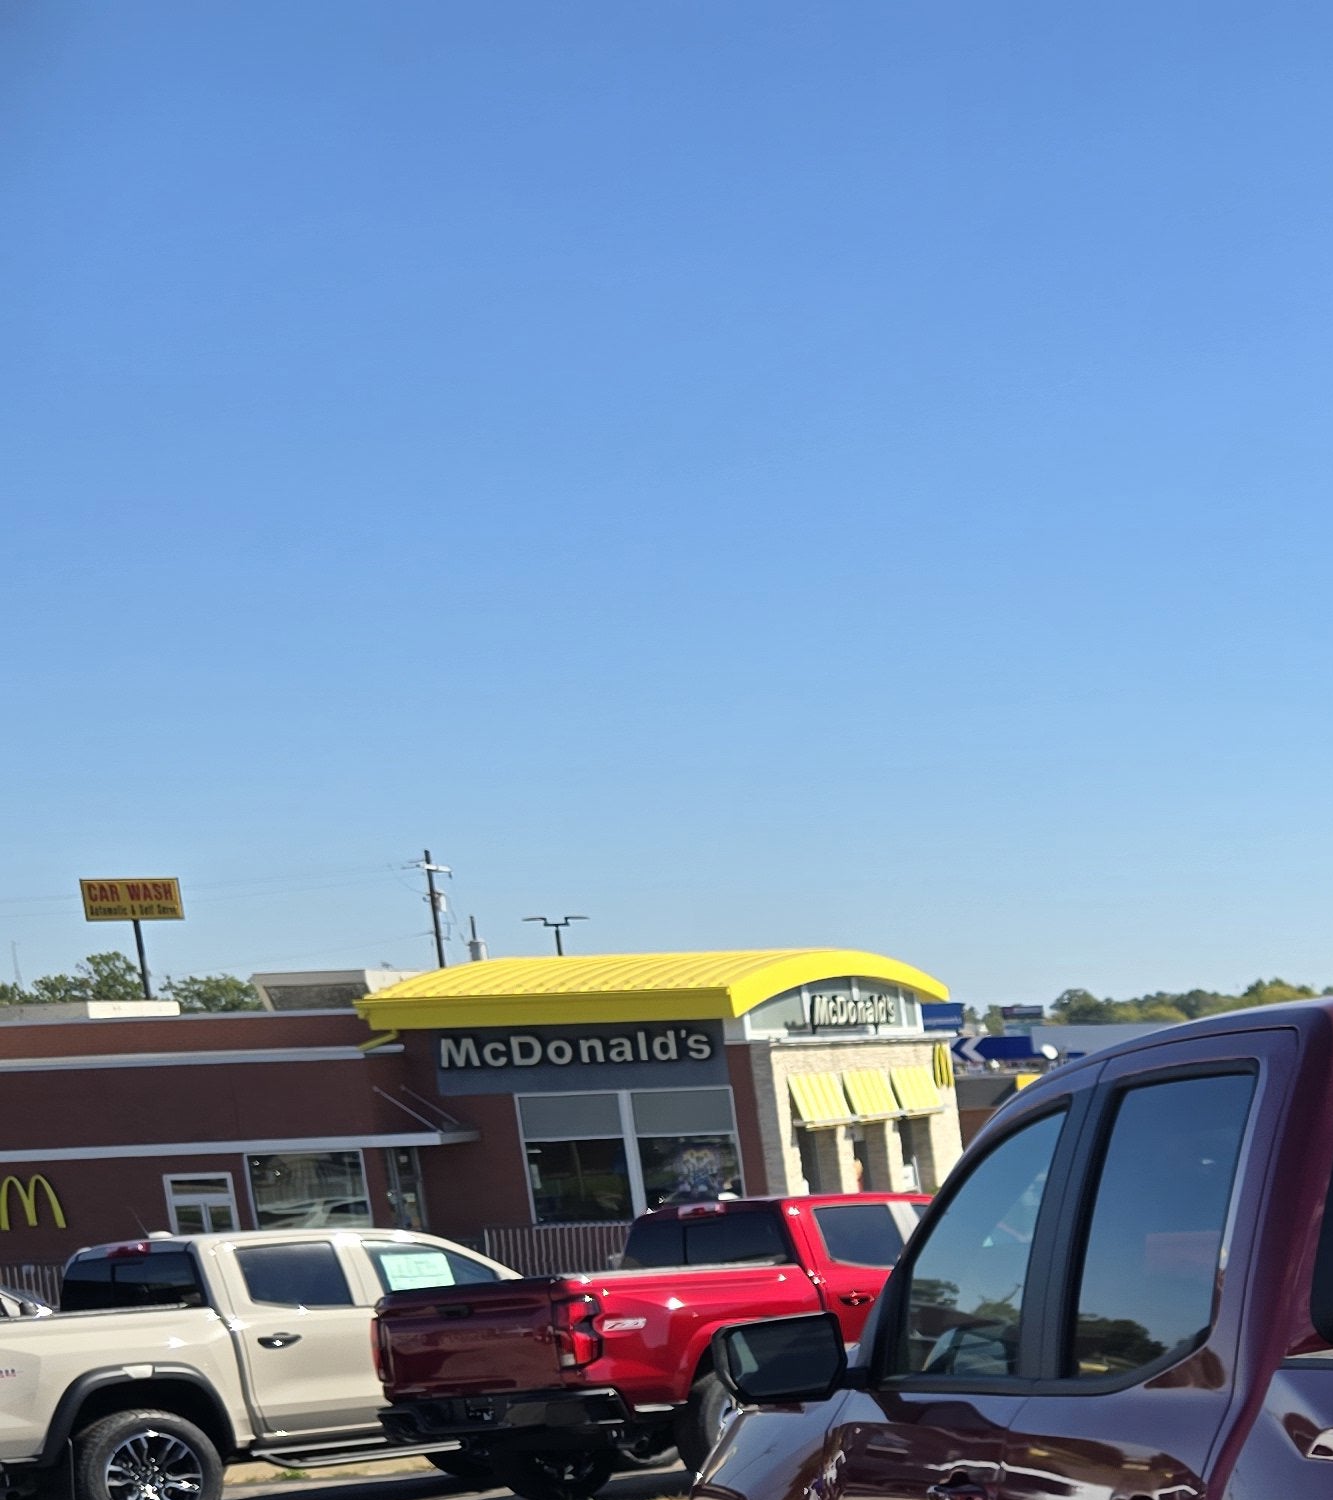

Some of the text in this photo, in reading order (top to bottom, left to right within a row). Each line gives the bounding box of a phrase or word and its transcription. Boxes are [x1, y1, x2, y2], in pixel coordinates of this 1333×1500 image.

[87, 881, 174, 902] CAR WASH
[812, 994, 896, 1027] McDonald's
[440, 1029, 712, 1068] McDonald's
